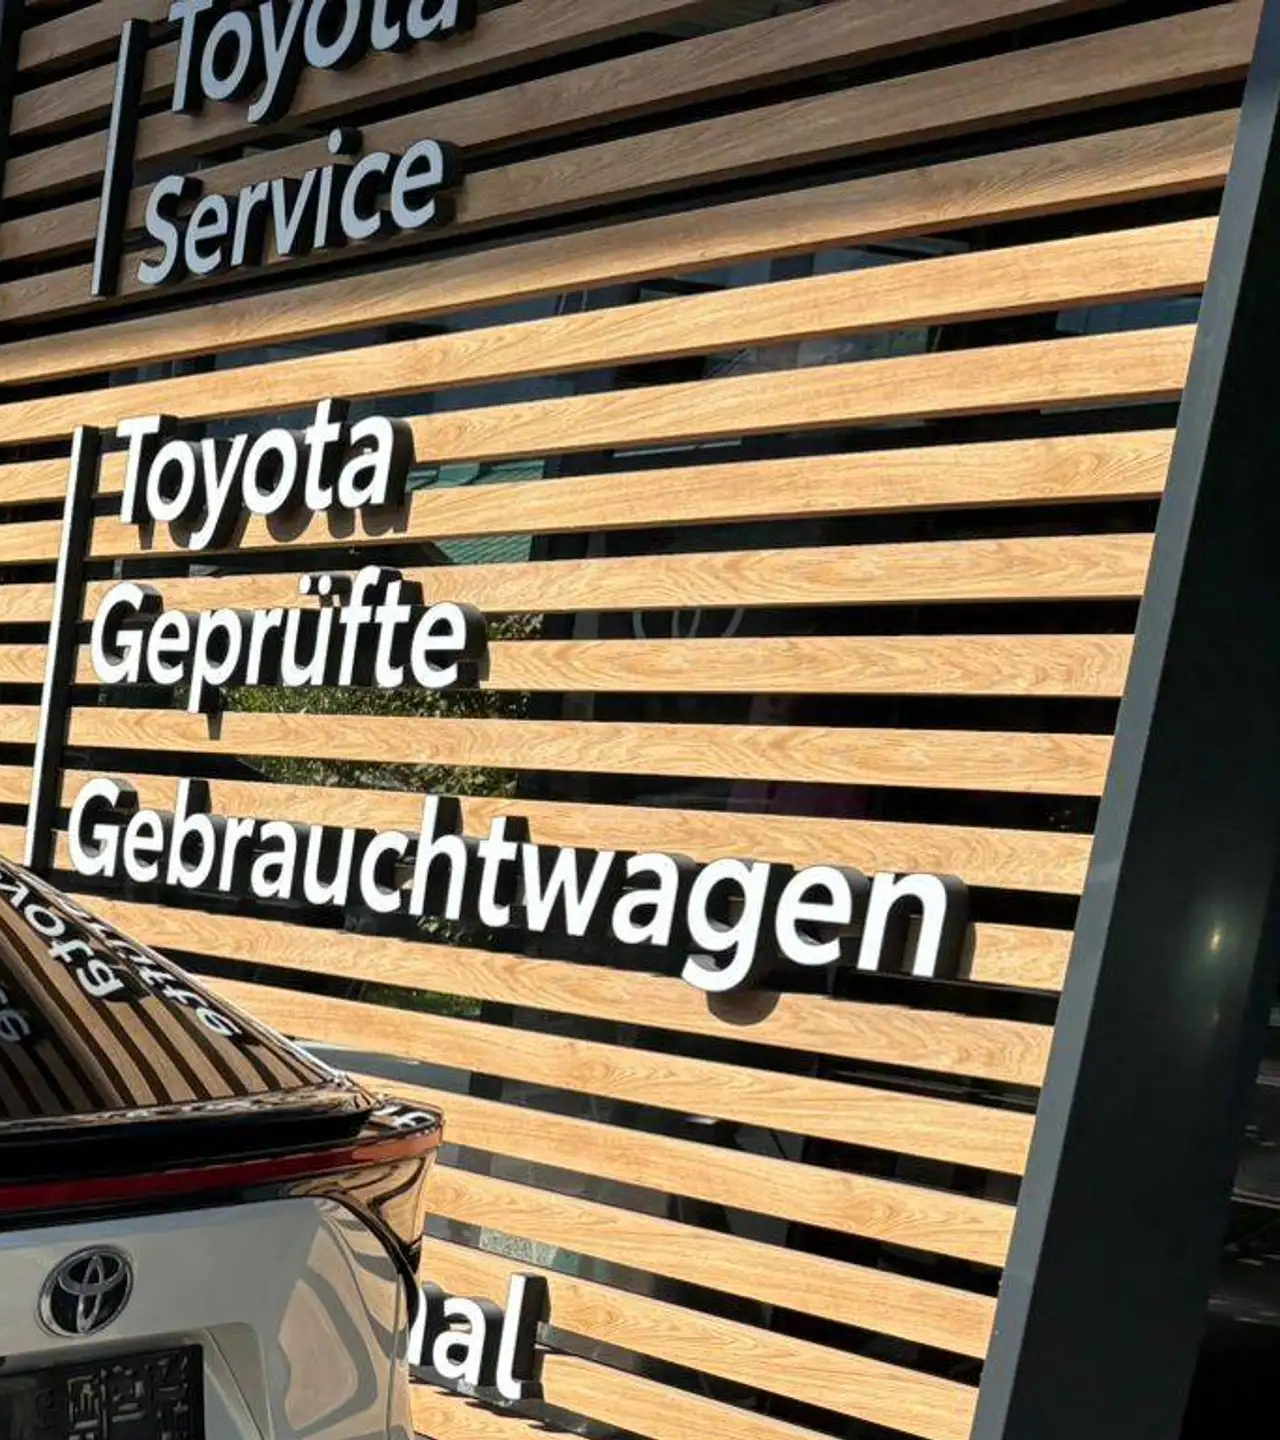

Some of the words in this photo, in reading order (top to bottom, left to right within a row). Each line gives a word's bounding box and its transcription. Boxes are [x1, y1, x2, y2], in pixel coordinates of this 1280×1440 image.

[137, 127, 444, 286] Service
[115, 396, 396, 551] Toyota
[90, 565, 468, 714] Geprüfte
[66, 777, 949, 992] Gebrauchtwagen
